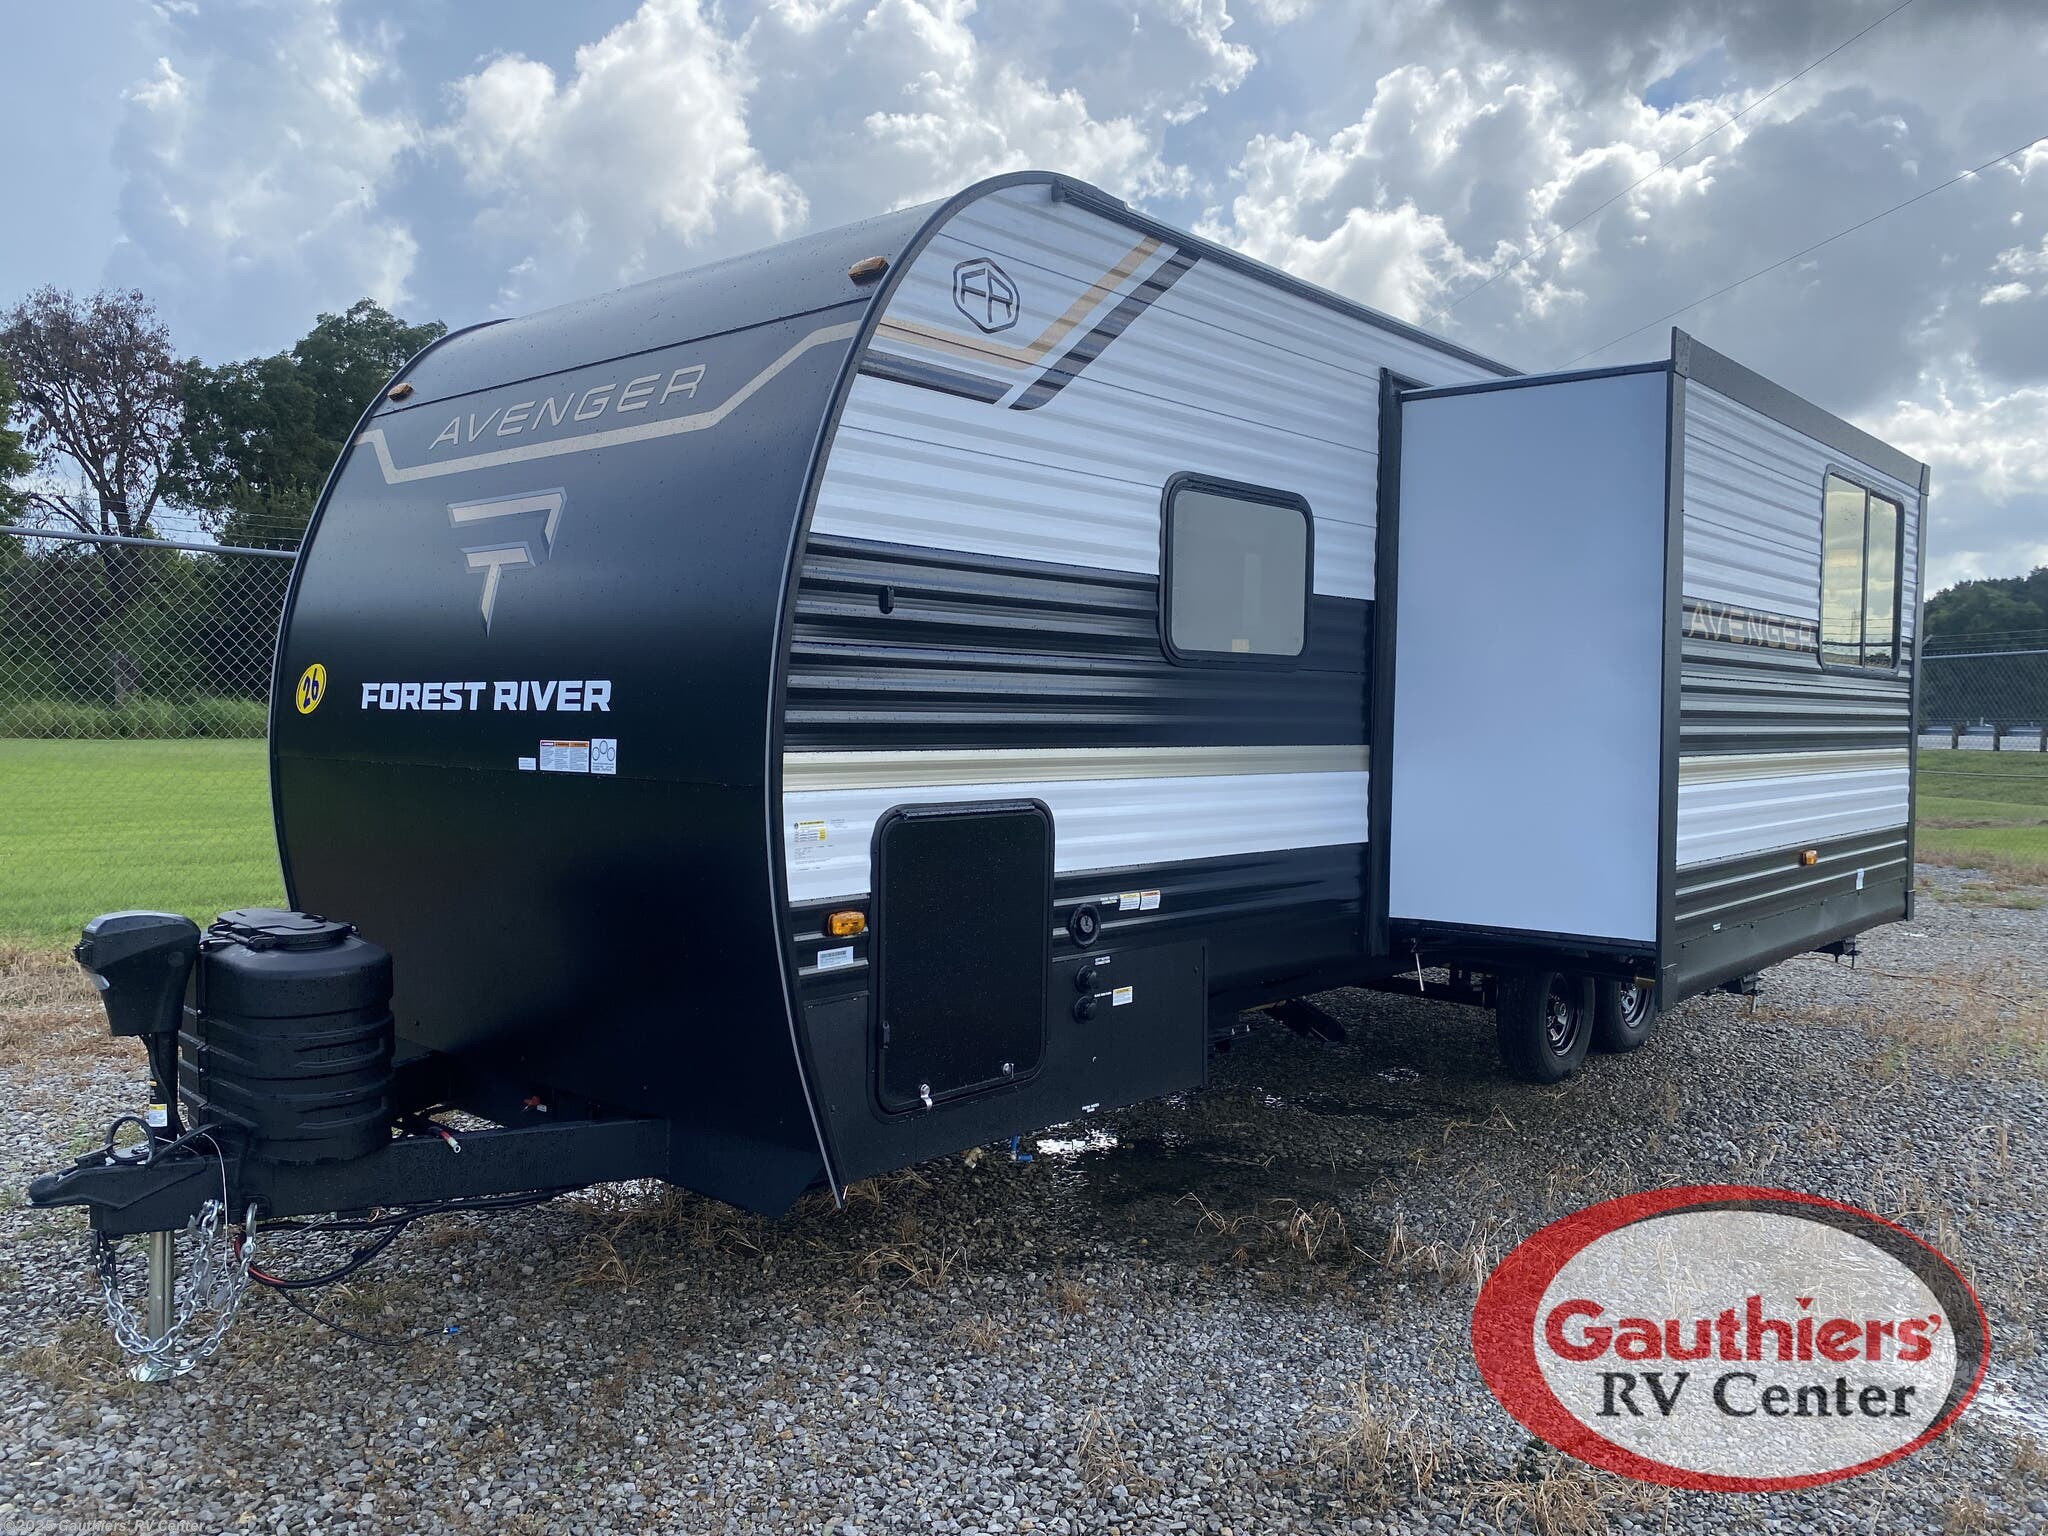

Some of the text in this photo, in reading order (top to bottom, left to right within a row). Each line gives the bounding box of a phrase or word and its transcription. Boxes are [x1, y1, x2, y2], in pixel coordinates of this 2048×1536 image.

[429, 364, 706, 448] AVENGER
[1689, 603, 1816, 652] AVENGER
[303, 668, 319, 709] 26
[361, 680, 611, 712] FOREST RIVER
